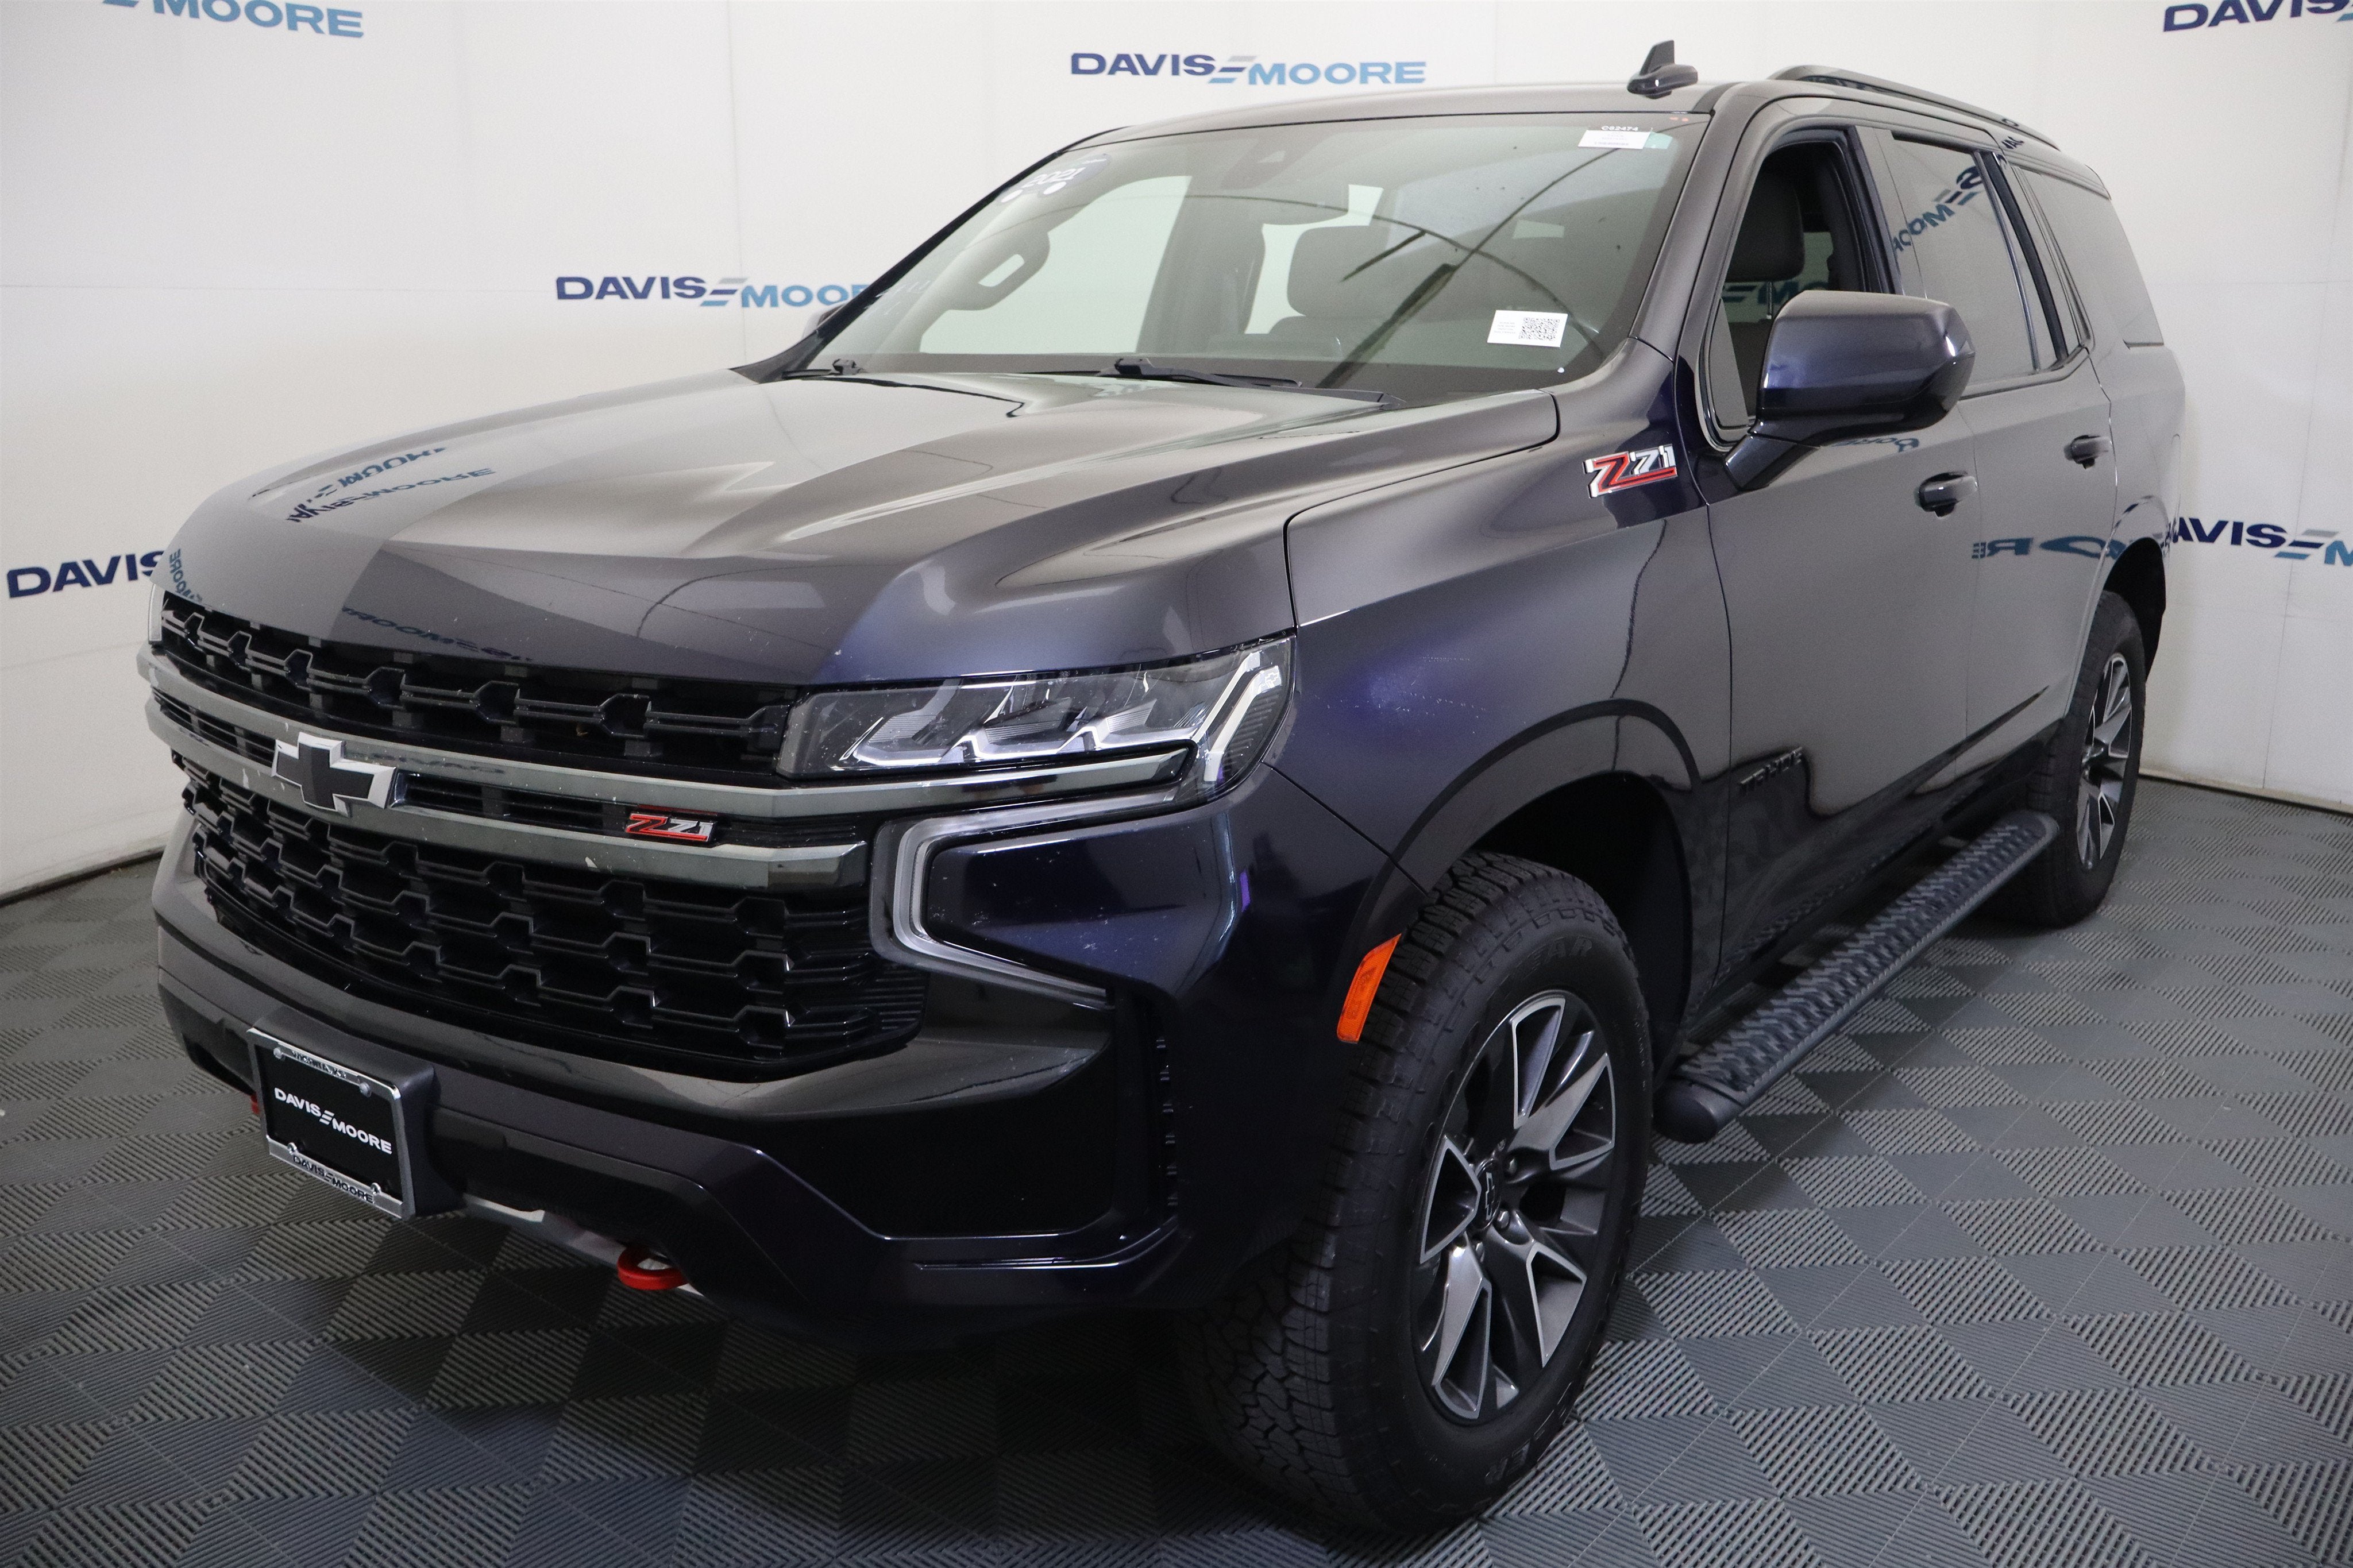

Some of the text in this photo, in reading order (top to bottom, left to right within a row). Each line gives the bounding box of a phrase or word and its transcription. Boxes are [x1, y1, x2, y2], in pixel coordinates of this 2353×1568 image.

[153, 0, 364, 38] MOORE
[1070, 52, 1426, 85] DAVIS MOORE
[555, 276, 707, 300] DAVIS
[740, 284, 872, 308] MOO
[1582, 444, 1678, 499] Z71
[2173, 516, 2288, 549] AVIS
[626, 813, 714, 842] Z71
[274, 1087, 392, 1155] DAVIS MOORE
[293, 1154, 374, 1204] DAVIS MOORE
